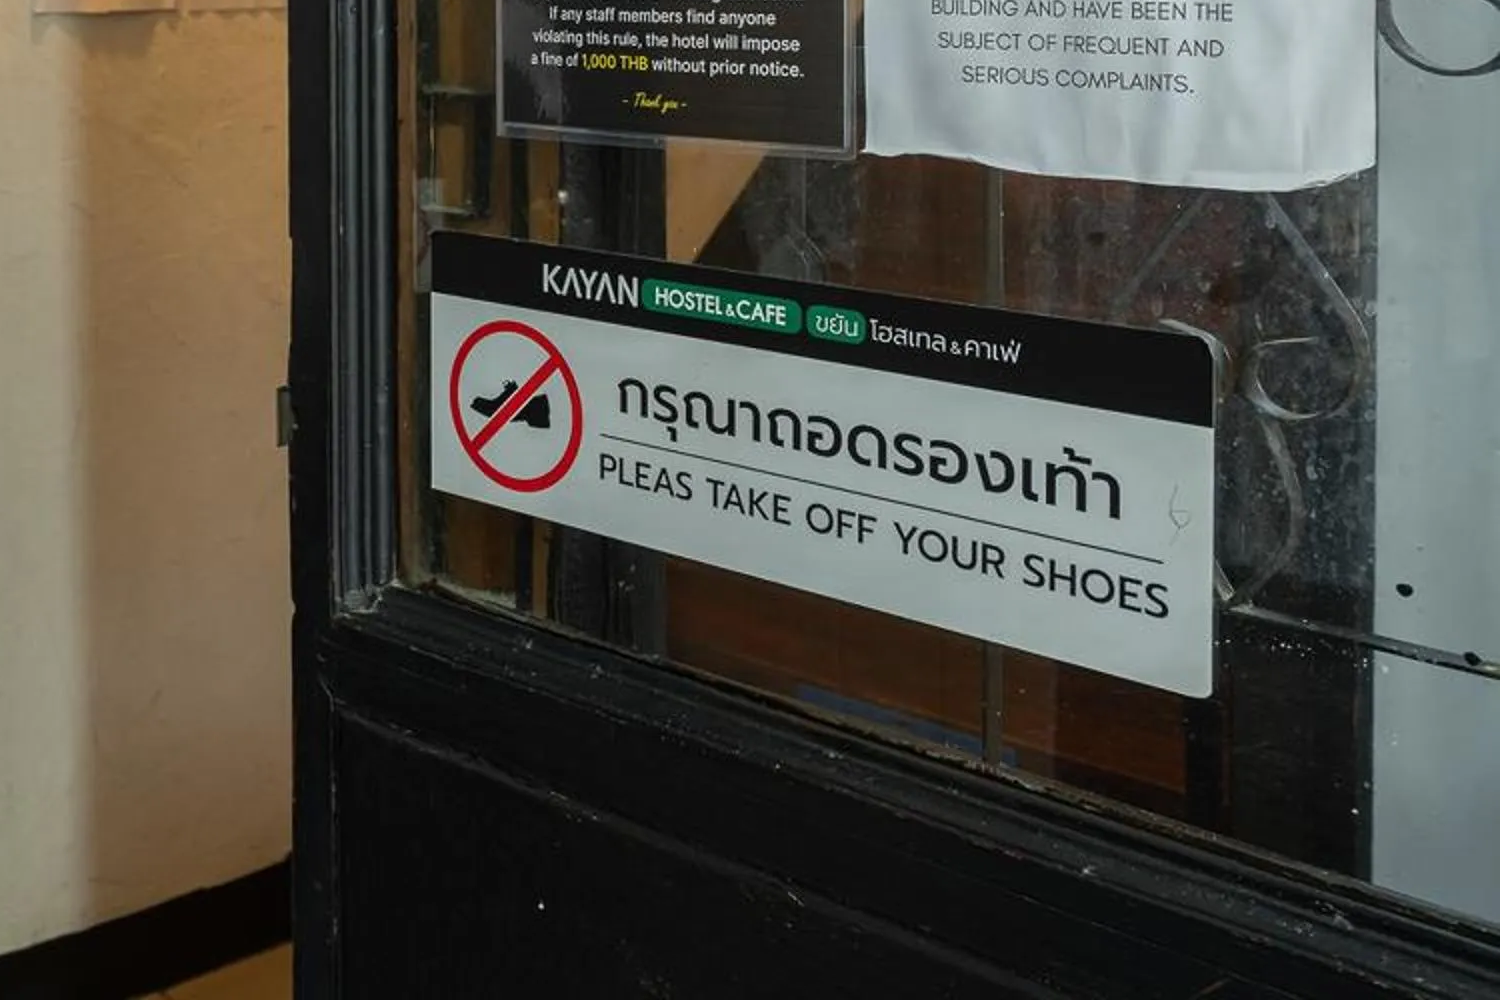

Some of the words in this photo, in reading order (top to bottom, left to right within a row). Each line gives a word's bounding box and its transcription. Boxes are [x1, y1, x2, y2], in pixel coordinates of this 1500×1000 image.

[550, 7, 558, 19] If
[560, 9, 582, 24] any
[586, 7, 616, 22] staff
[619, 8, 683, 24] members
[687, 9, 715, 24] find
[719, 12, 776, 29] anyone
[1024, 0, 1065, 18] AND
[1073, 1, 1122, 18] HAVE
[1131, 2, 1187, 20] BEEN
[1195, 3, 1233, 22] THE
[532, 29, 583, 48] violating
[586, 31, 610, 46] this
[613, 34, 642, 50] rule,
[646, 33, 669, 47] the
[672, 34, 709, 49] hotel
[713, 35, 738, 50] will
[742, 36, 800, 54] impose
[938, 32, 1021, 50] SUBJECT
[1028, 34, 1056, 51] OF
[1063, 36, 1169, 57] FREQUENT
[1177, 39, 1224, 58] AND
[531, 55, 538, 65] a
[541, 53, 563, 67] fine
[566, 54, 579, 67] of
[582, 55, 616, 71] 1,000
[620, 56, 648, 71] THB
[652, 57, 705, 74] without
[709, 60, 746, 78] prior
[750, 62, 804, 78] notice.
[962, 66, 1049, 86] SERIOUS
[1055, 69, 1195, 94] COMPLAINTS.
[542, 263, 639, 308] KAYAN
[654, 286, 787, 326] HOSTEL&CAFE
[815, 314, 859, 337] ขยัน
[618, 376, 1122, 520] กรุณาถอดรองเท้า
[600, 454, 693, 501] PLEAS
[706, 478, 792, 525] TAKE
[806, 504, 878, 544] OFF
[892, 521, 1006, 578] YOUR
[1022, 553, 1170, 618] SHOES
